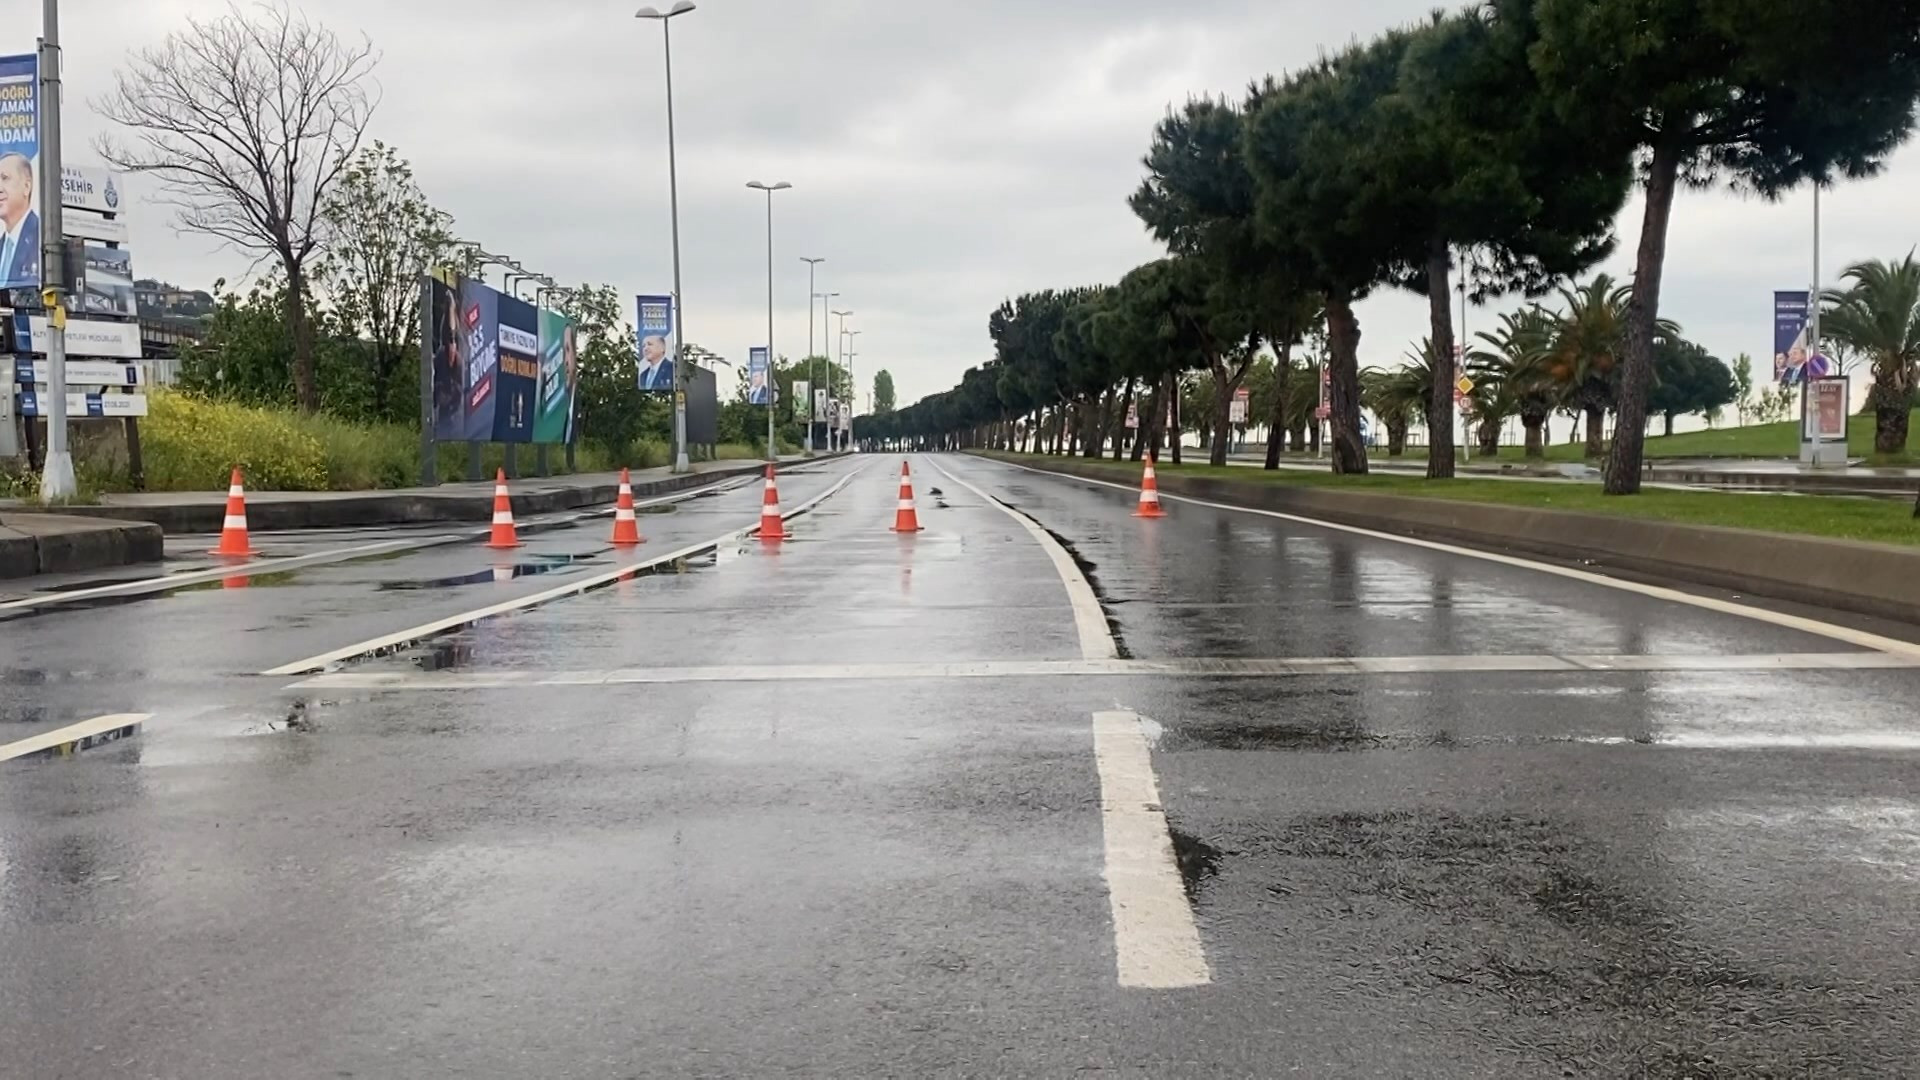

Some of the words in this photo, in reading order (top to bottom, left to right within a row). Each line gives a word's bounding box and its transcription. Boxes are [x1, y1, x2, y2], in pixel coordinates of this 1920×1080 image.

[0, 84, 33, 101] OĞRU
[0, 99, 34, 115] AMAN
[0, 113, 34, 130] OĞRU
